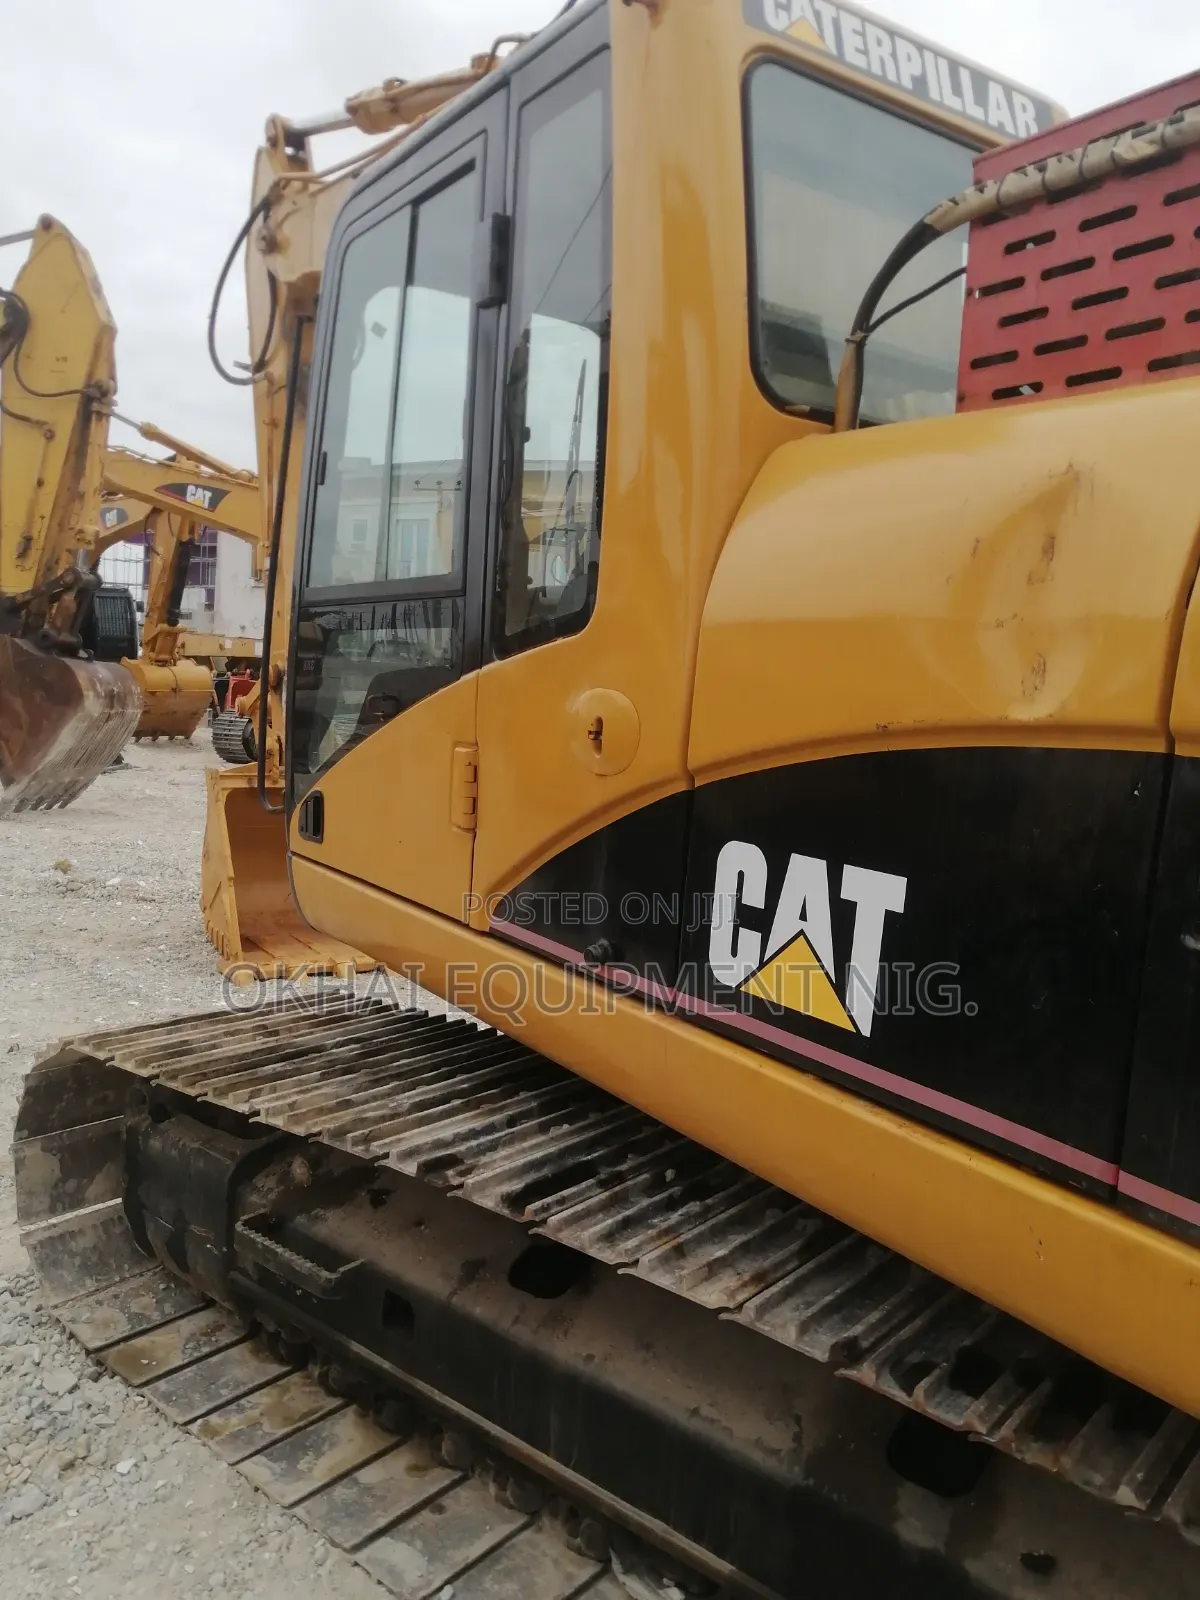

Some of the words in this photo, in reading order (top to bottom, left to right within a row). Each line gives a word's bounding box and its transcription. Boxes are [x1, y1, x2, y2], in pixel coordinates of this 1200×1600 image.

[763, 0, 1039, 138] CATERPILLAR
[186, 484, 213, 509] CAT
[708, 840, 908, 1038] CAT
